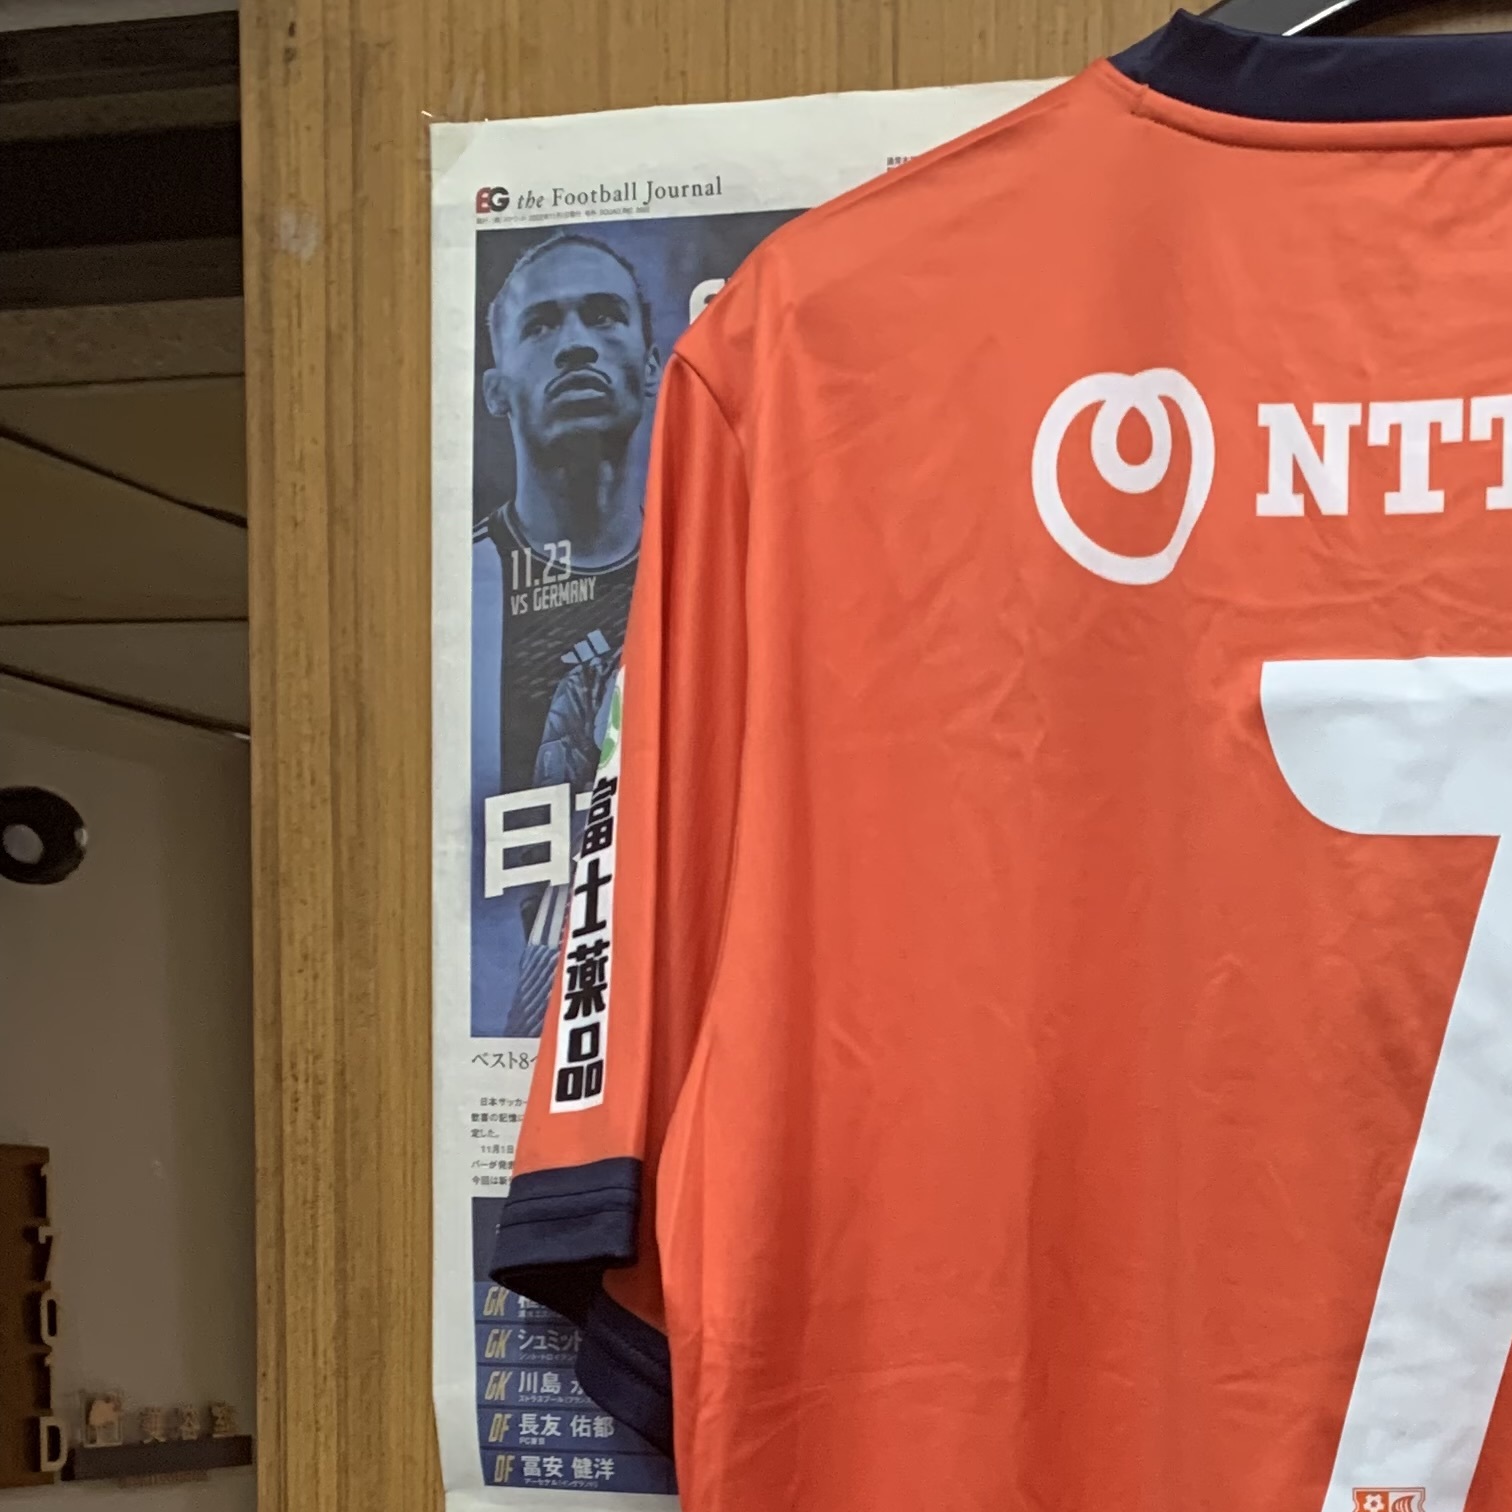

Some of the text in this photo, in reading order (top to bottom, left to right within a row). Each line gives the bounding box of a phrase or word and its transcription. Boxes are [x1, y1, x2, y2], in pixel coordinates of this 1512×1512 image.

[517, 190, 545, 210] the
[552, 181, 637, 207] Football
[643, 176, 722, 205] Journal
[511, 540, 572, 591] 11.23
[511, 576, 597, 616] VS GERMANY
[485, 783, 592, 898] 日
[555, 776, 617, 1102] 富士薬品
[483, 1286, 509, 1316] GK
[485, 1329, 583, 1359] GK シュミット
[485, 1371, 513, 1401] GK
[518, 1371, 561, 1395] 川島
[488, 1413, 614, 1442] DF 長友 佑都
[493, 1454, 515, 1483] DF
[571, 1456, 614, 1480] 健洋
